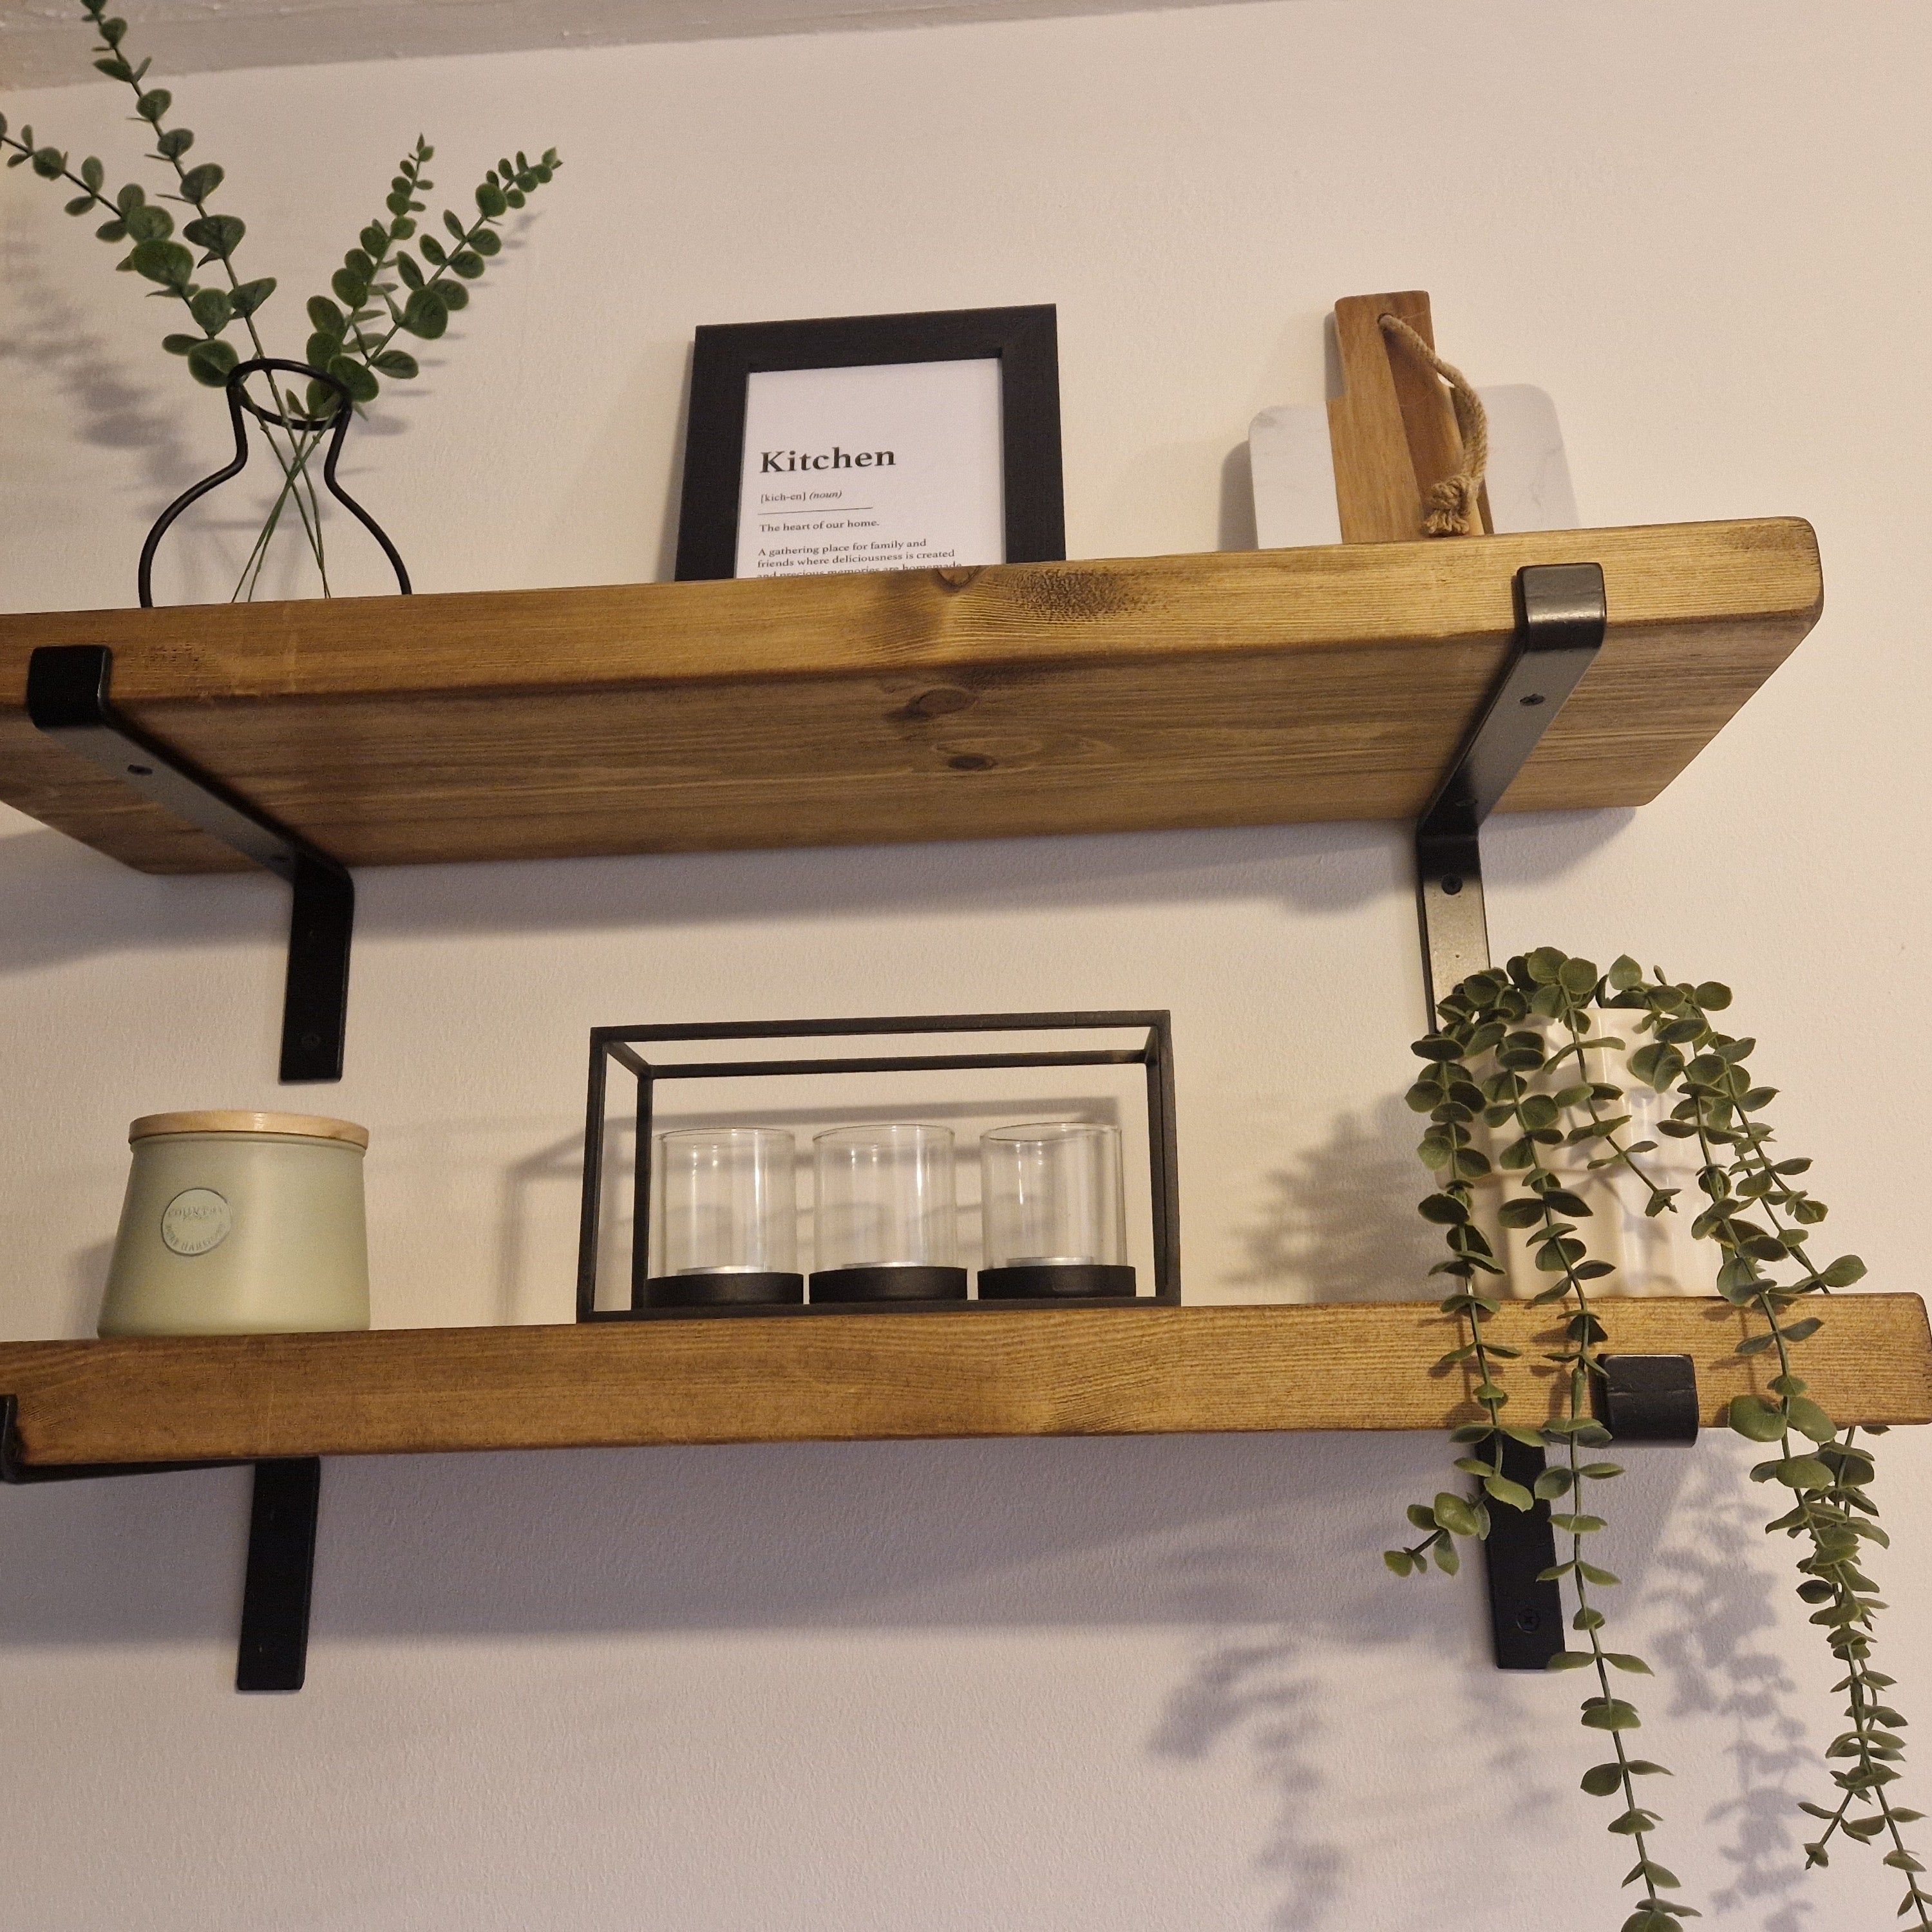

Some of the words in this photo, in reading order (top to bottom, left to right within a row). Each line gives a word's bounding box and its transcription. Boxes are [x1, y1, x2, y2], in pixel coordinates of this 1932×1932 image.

[759, 446, 896, 473] Kitchen
[761, 491, 806, 504] [kich-en]
[809, 489, 842, 500] (noun)
[813, 521, 825, 529] of
[848, 520, 880, 528] home.
[769, 546, 819, 557] gathering
[822, 544, 849, 554] place
[853, 542, 867, 551] for
[871, 540, 904, 550] family
[906, 538, 927, 547] and
[757, 558, 794, 568] friends
[797, 557, 829, 565] where
[832, 554, 903, 564] deliciousness
[916, 549, 955, 559] created
